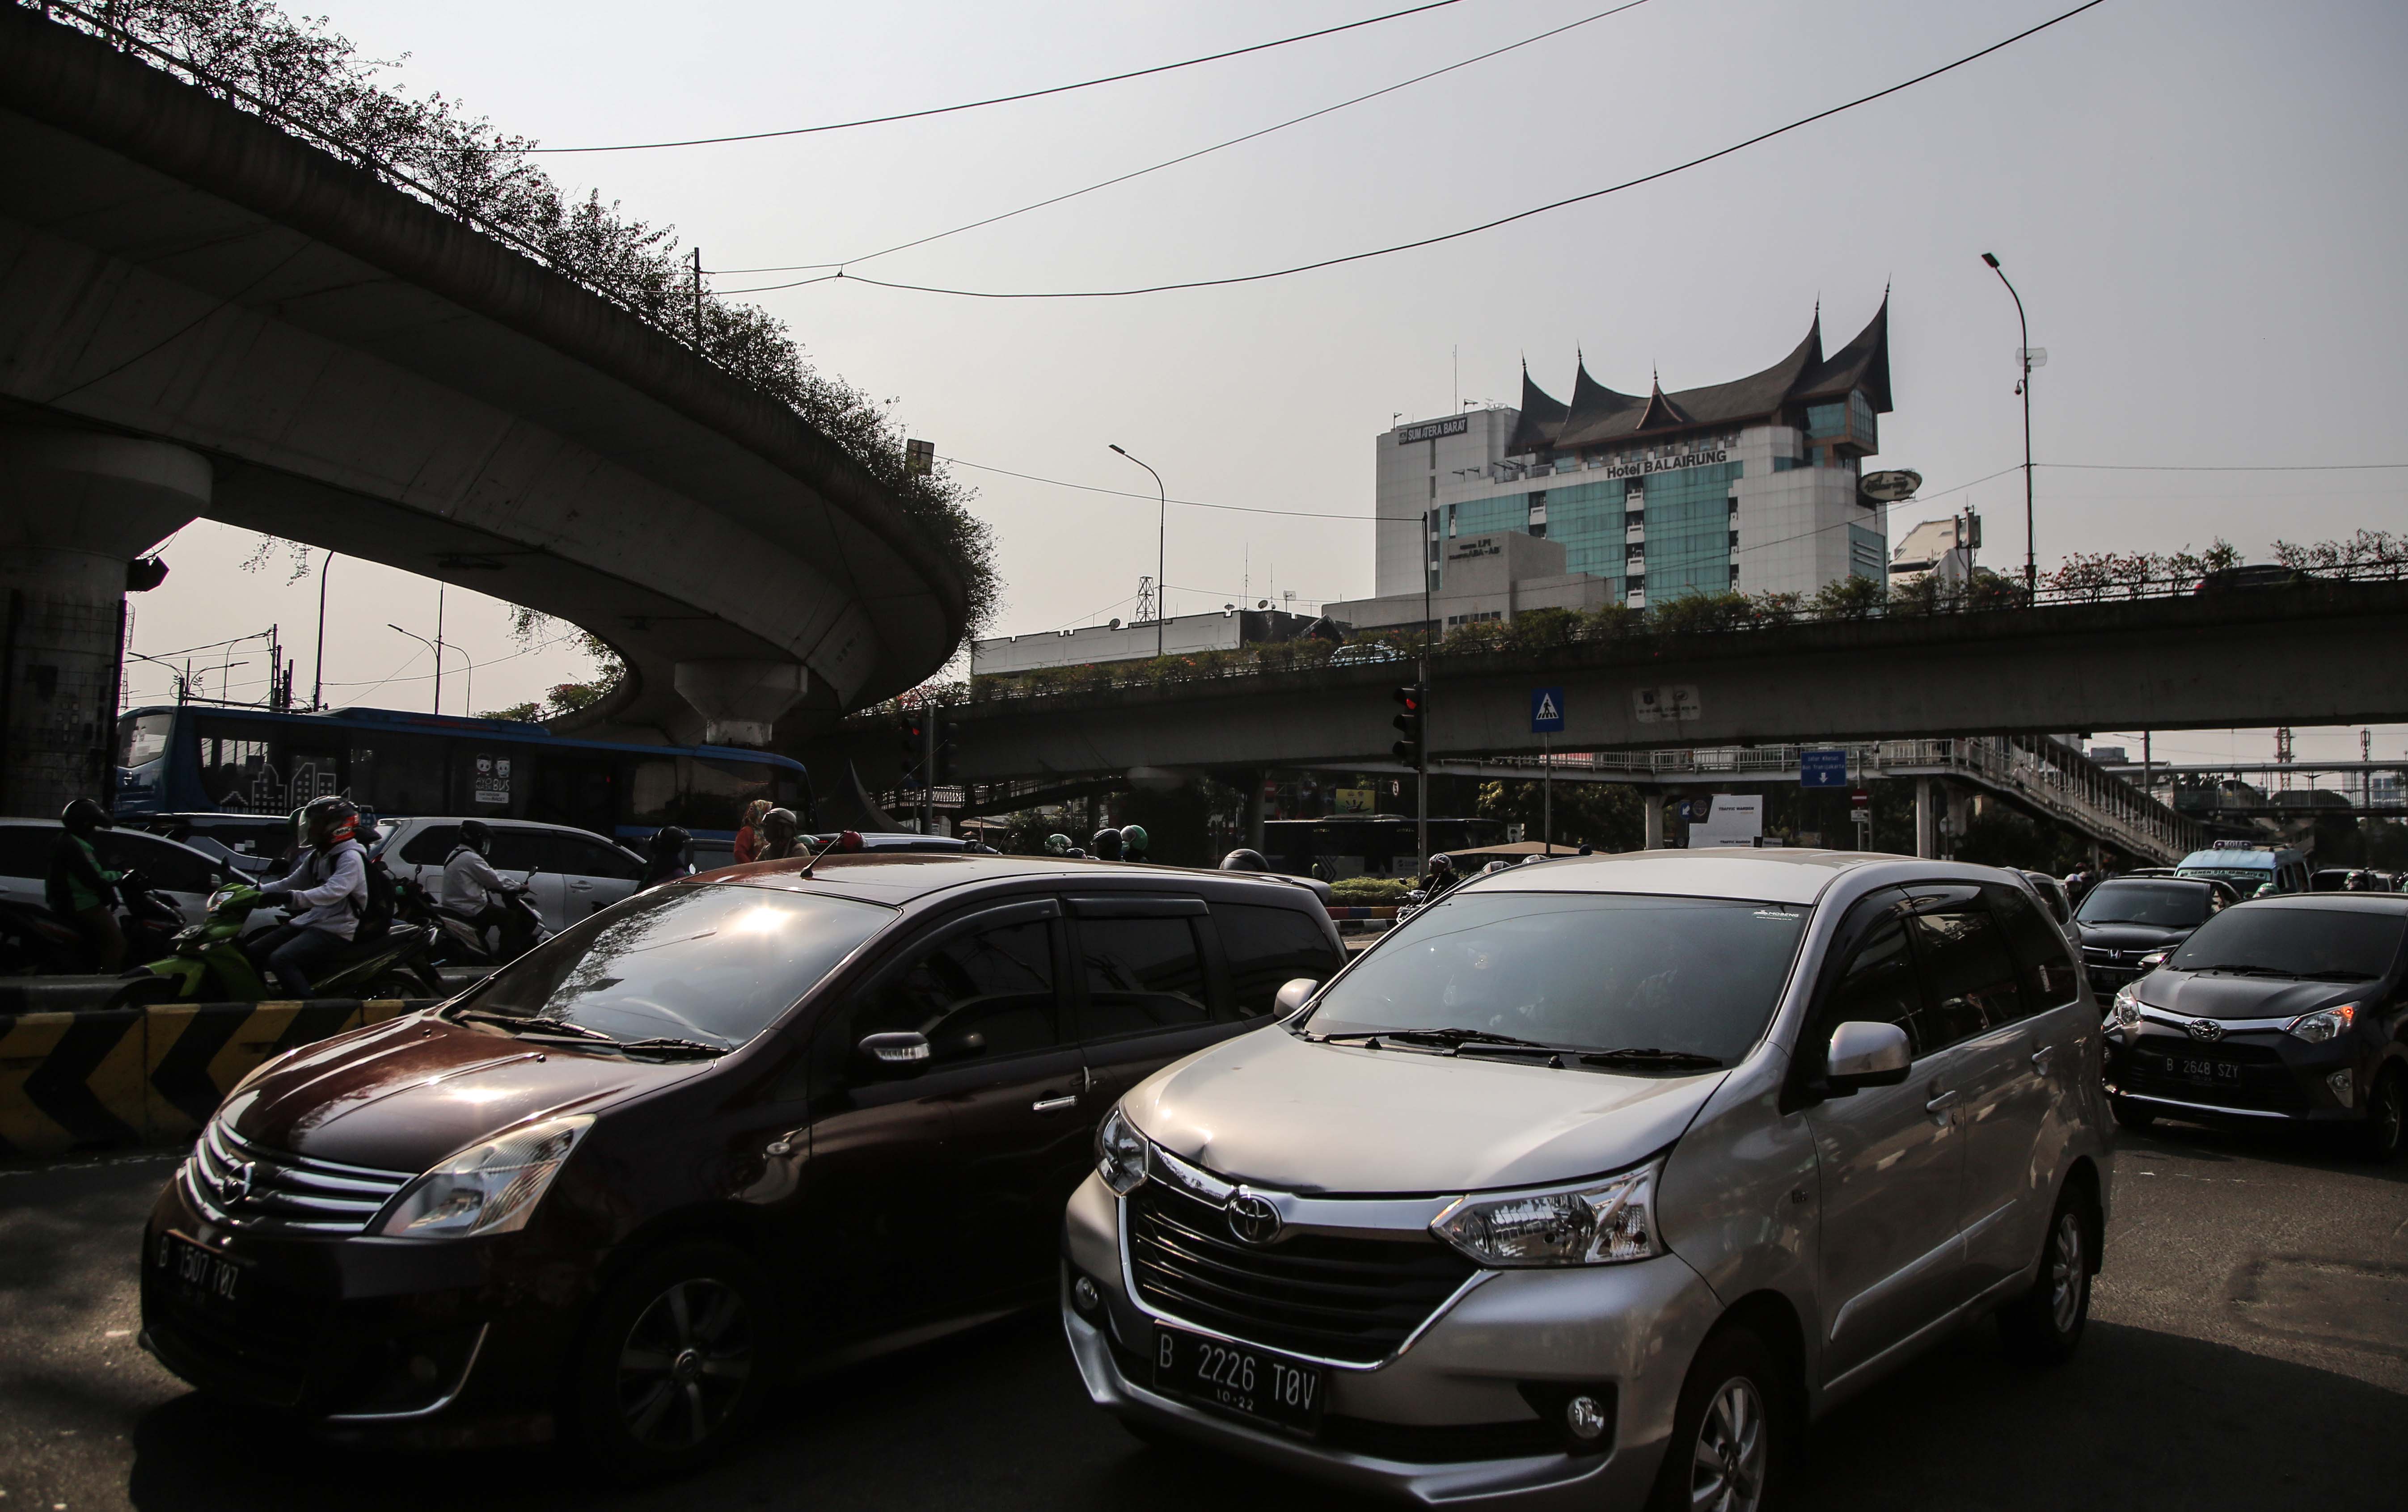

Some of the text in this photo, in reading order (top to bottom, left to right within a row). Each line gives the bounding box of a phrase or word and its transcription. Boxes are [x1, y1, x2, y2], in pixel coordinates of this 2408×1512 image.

[1408, 420, 1466, 440] SUMATERA BARAT
[1607, 450, 1727, 479] Hotel BALAIRUNG
[493, 779, 510, 792] BUS
[2167, 1058, 2173, 1071] B
[2183, 1060, 2211, 1075] 2648
[2218, 1063, 2239, 1078] SZY
[159, 1236, 169, 1268] B
[1160, 1334, 1173, 1368] B
[1198, 1344, 1255, 1391] 2226
